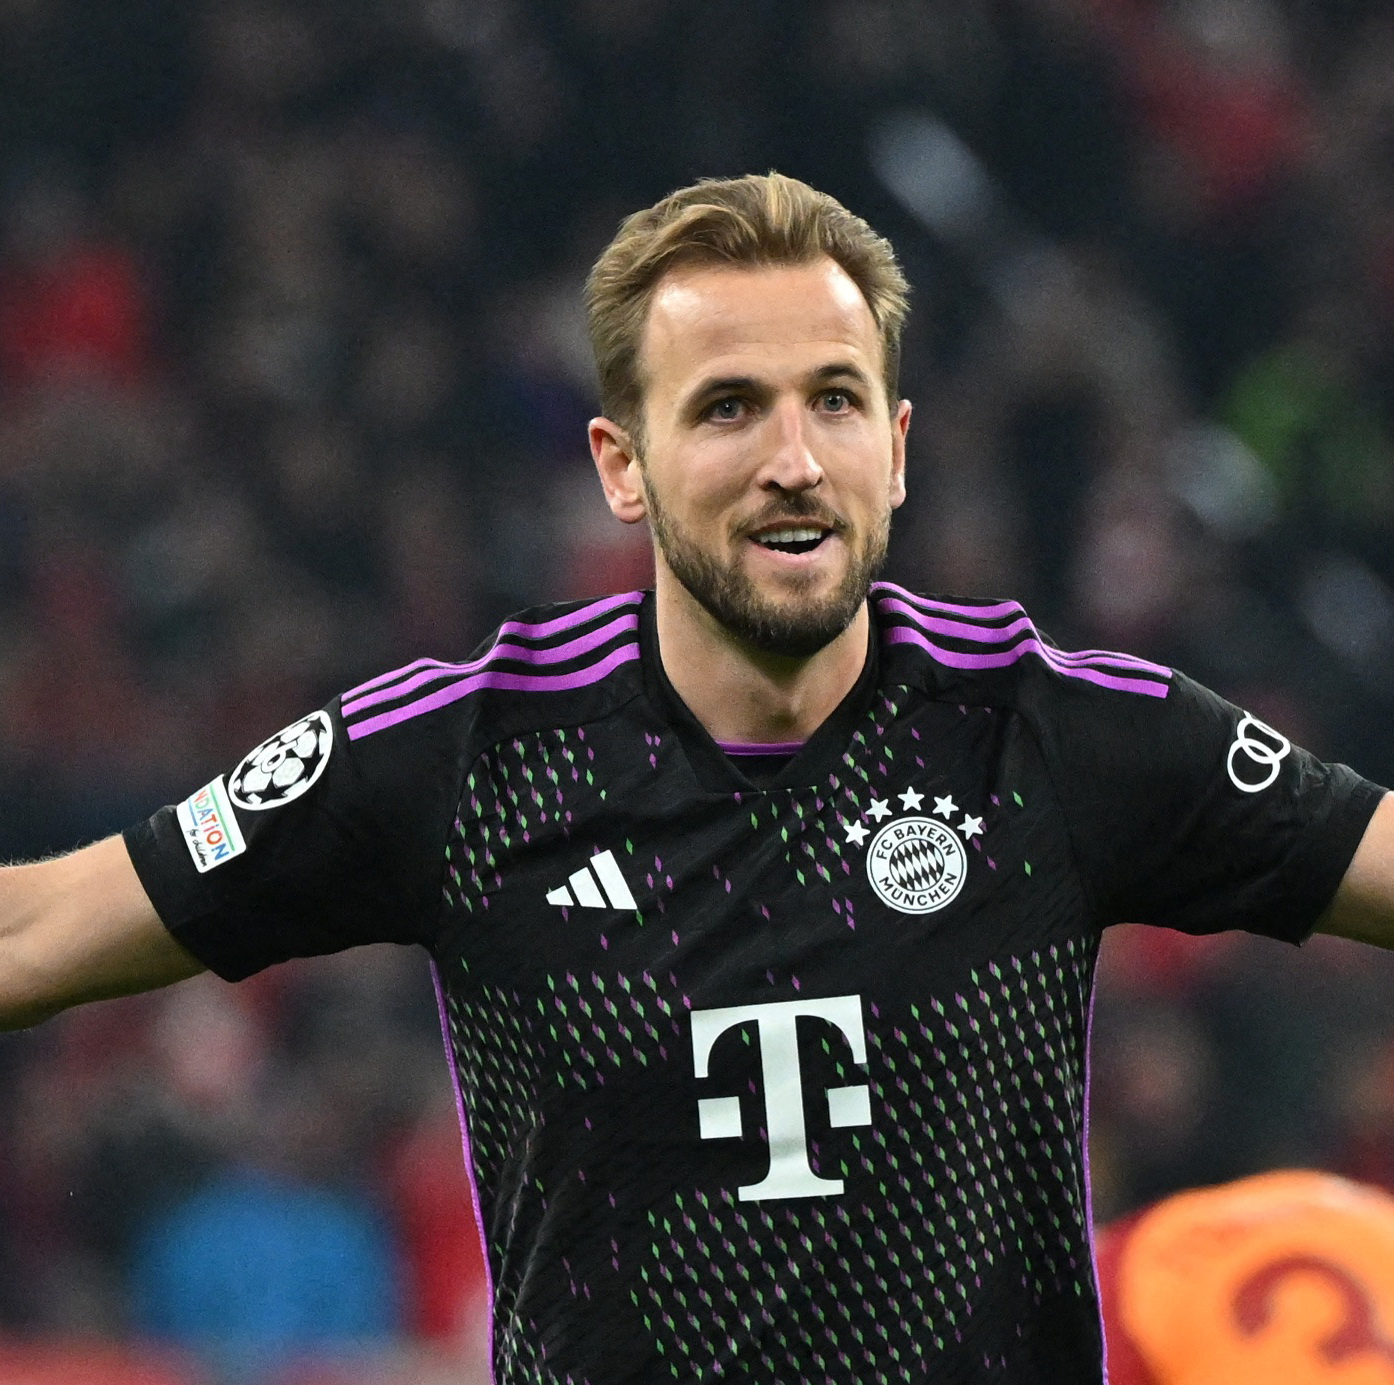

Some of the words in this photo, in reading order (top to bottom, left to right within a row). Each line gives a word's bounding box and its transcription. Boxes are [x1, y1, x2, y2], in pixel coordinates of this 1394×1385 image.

[876, 838, 894, 860] FC
[893, 824, 956, 857] BAYERN
[878, 872, 958, 907] MÜNCHEN
[690, 994, 872, 1202] T
